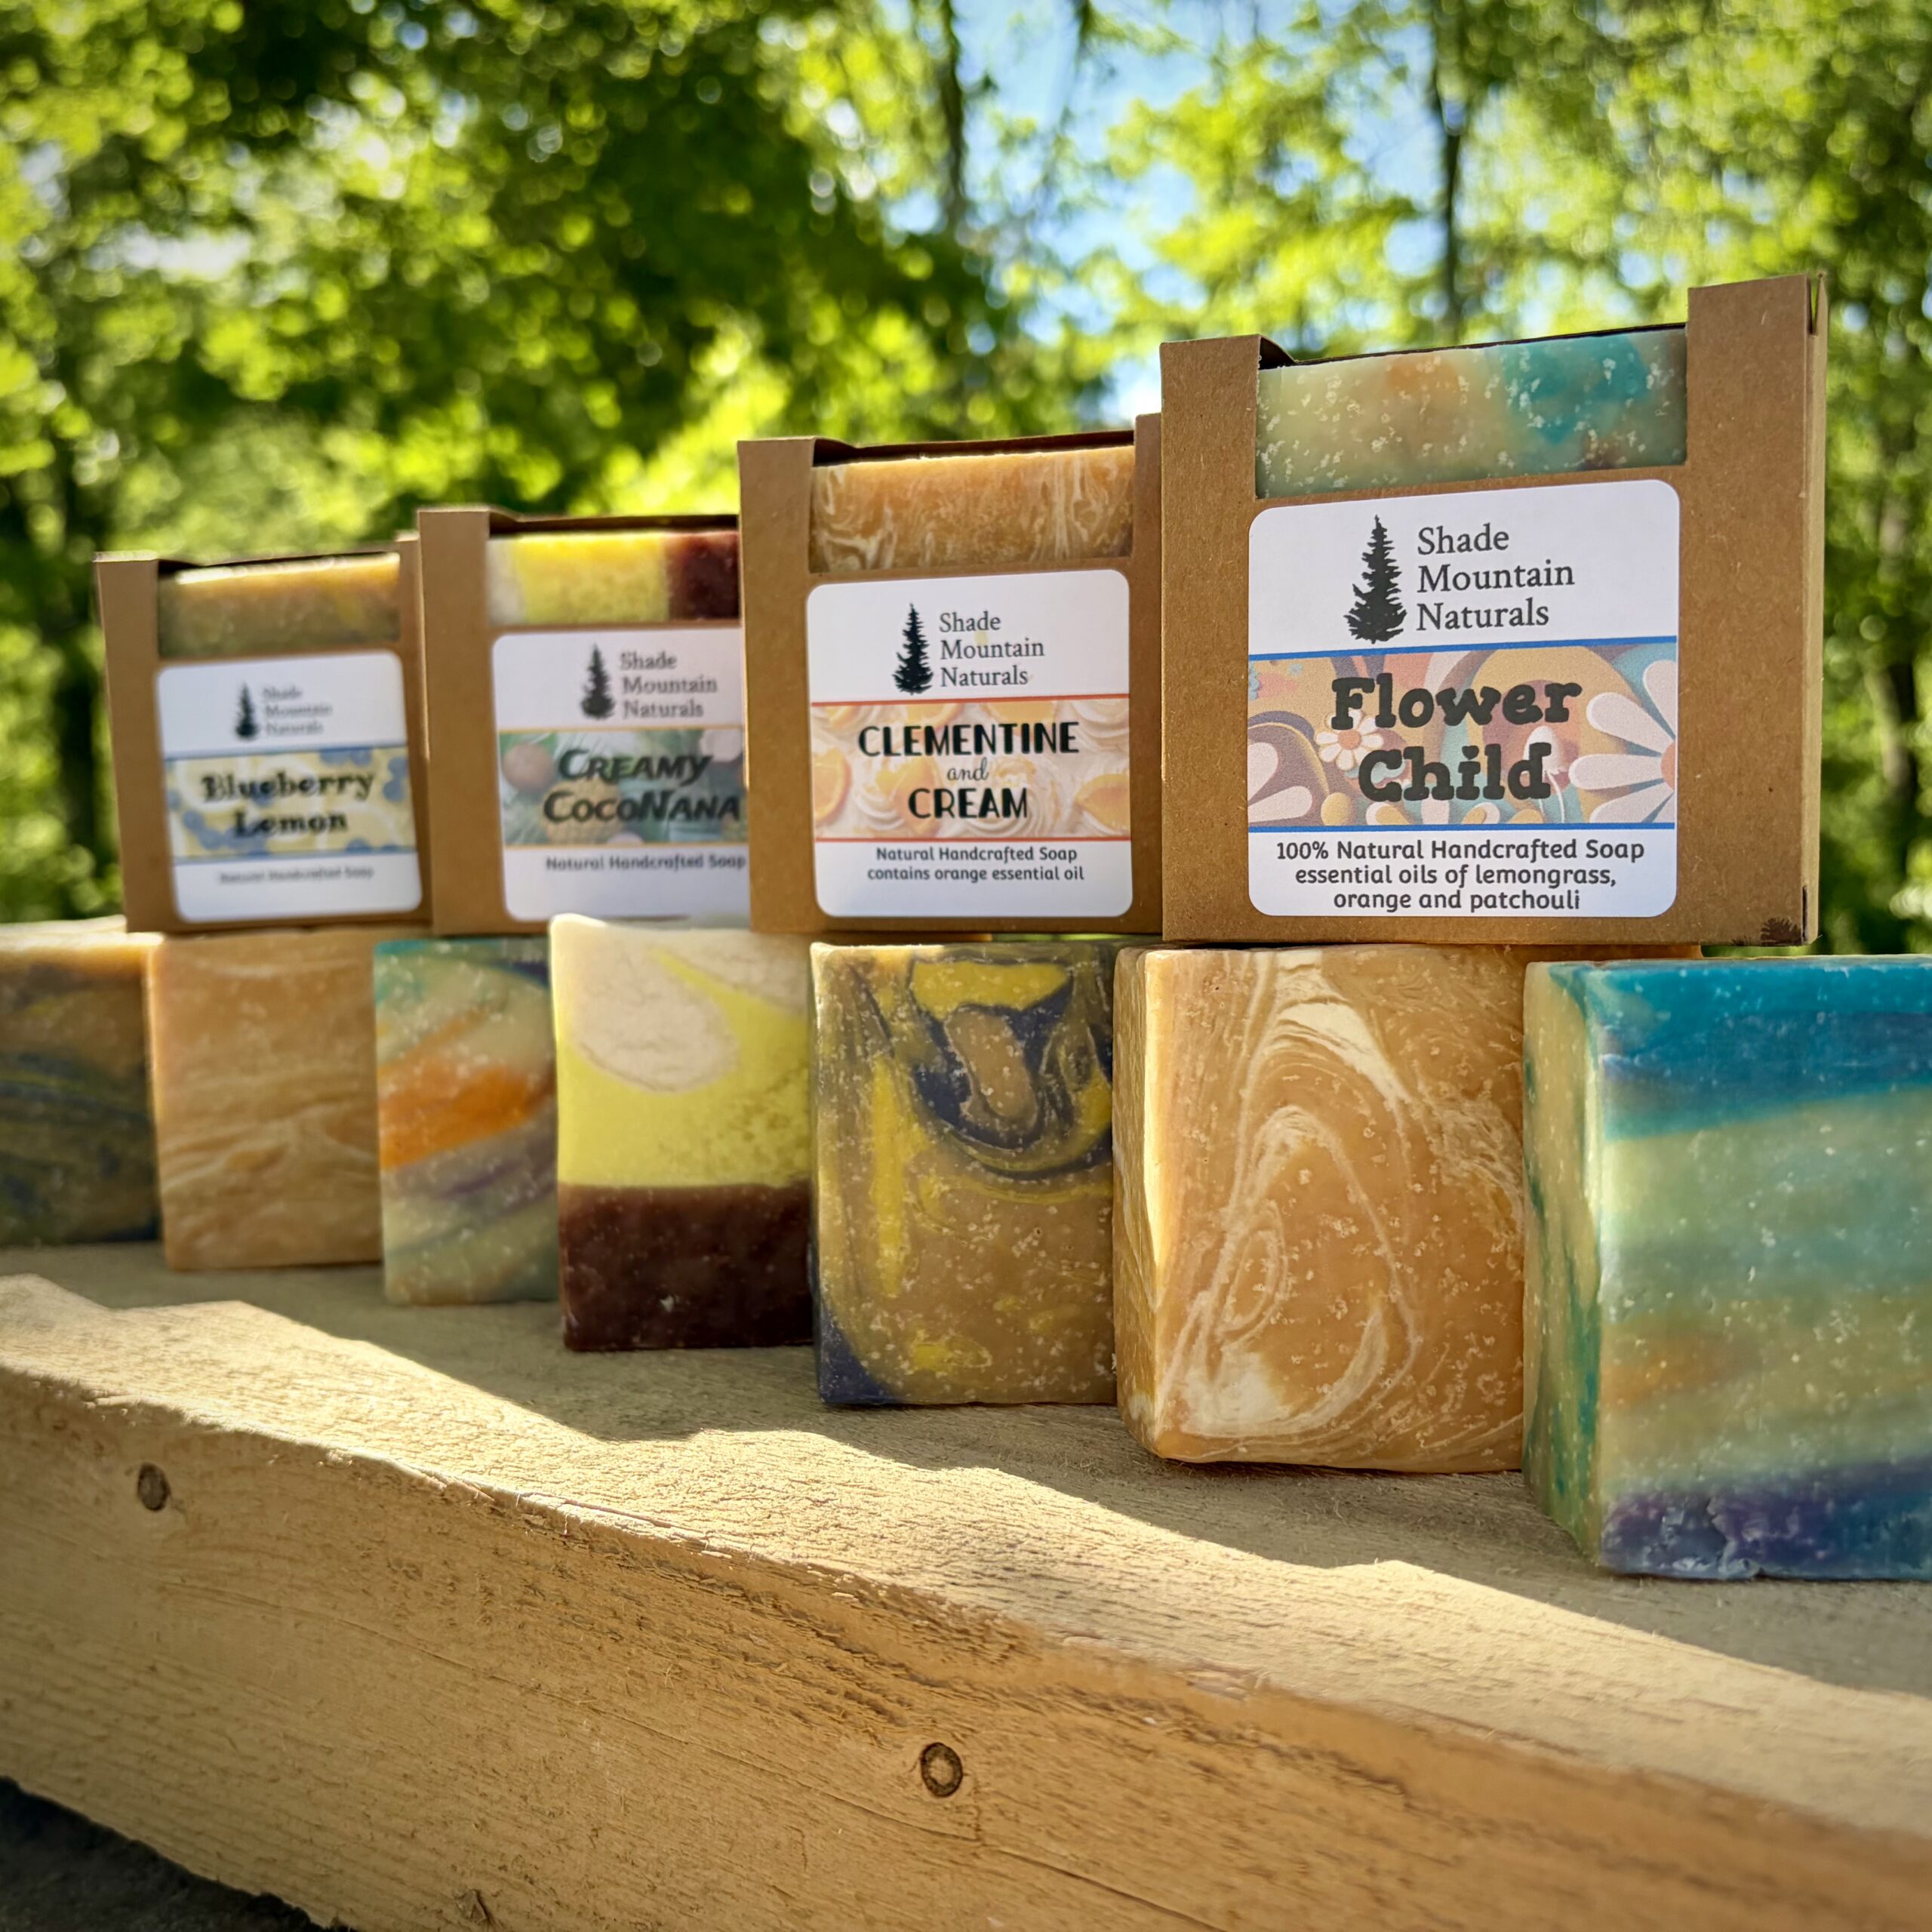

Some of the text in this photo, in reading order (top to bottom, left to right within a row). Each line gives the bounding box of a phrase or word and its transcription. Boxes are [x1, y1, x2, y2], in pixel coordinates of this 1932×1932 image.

[1417, 523, 1509, 555] Shade
[1417, 560, 1575, 593] Mountain
[939, 611, 1001, 632] Shade
[1417, 598, 1549, 632] Naturals
[940, 638, 1045, 660] Mountain
[619, 652, 677, 670] Shade
[623, 675, 718, 694] Mountain
[940, 665, 1028, 688] Naturals
[623, 699, 703, 719] Naturals
[1331, 673, 1582, 731] Flower
[858, 721, 1079, 757] CLEMENTINE
[947, 758, 989, 781] and
[1359, 741, 1552, 801] Child
[202, 769, 374, 802] Blueberry
[908, 788, 1028, 819] CREAM
[233, 808, 347, 838] Lemon
[876, 847, 1077, 863] Natural Handcrafted Soap
[1277, 839, 1644, 863] 100% Natural Handcrafted Soap
[546, 854, 745, 872] Natural Handcrafted Soap
[868, 866, 1084, 883] contains orange essential oil
[1295, 865, 1617, 889] essential oils of lemongrass,
[1334, 890, 1580, 912] orange and patchouli
